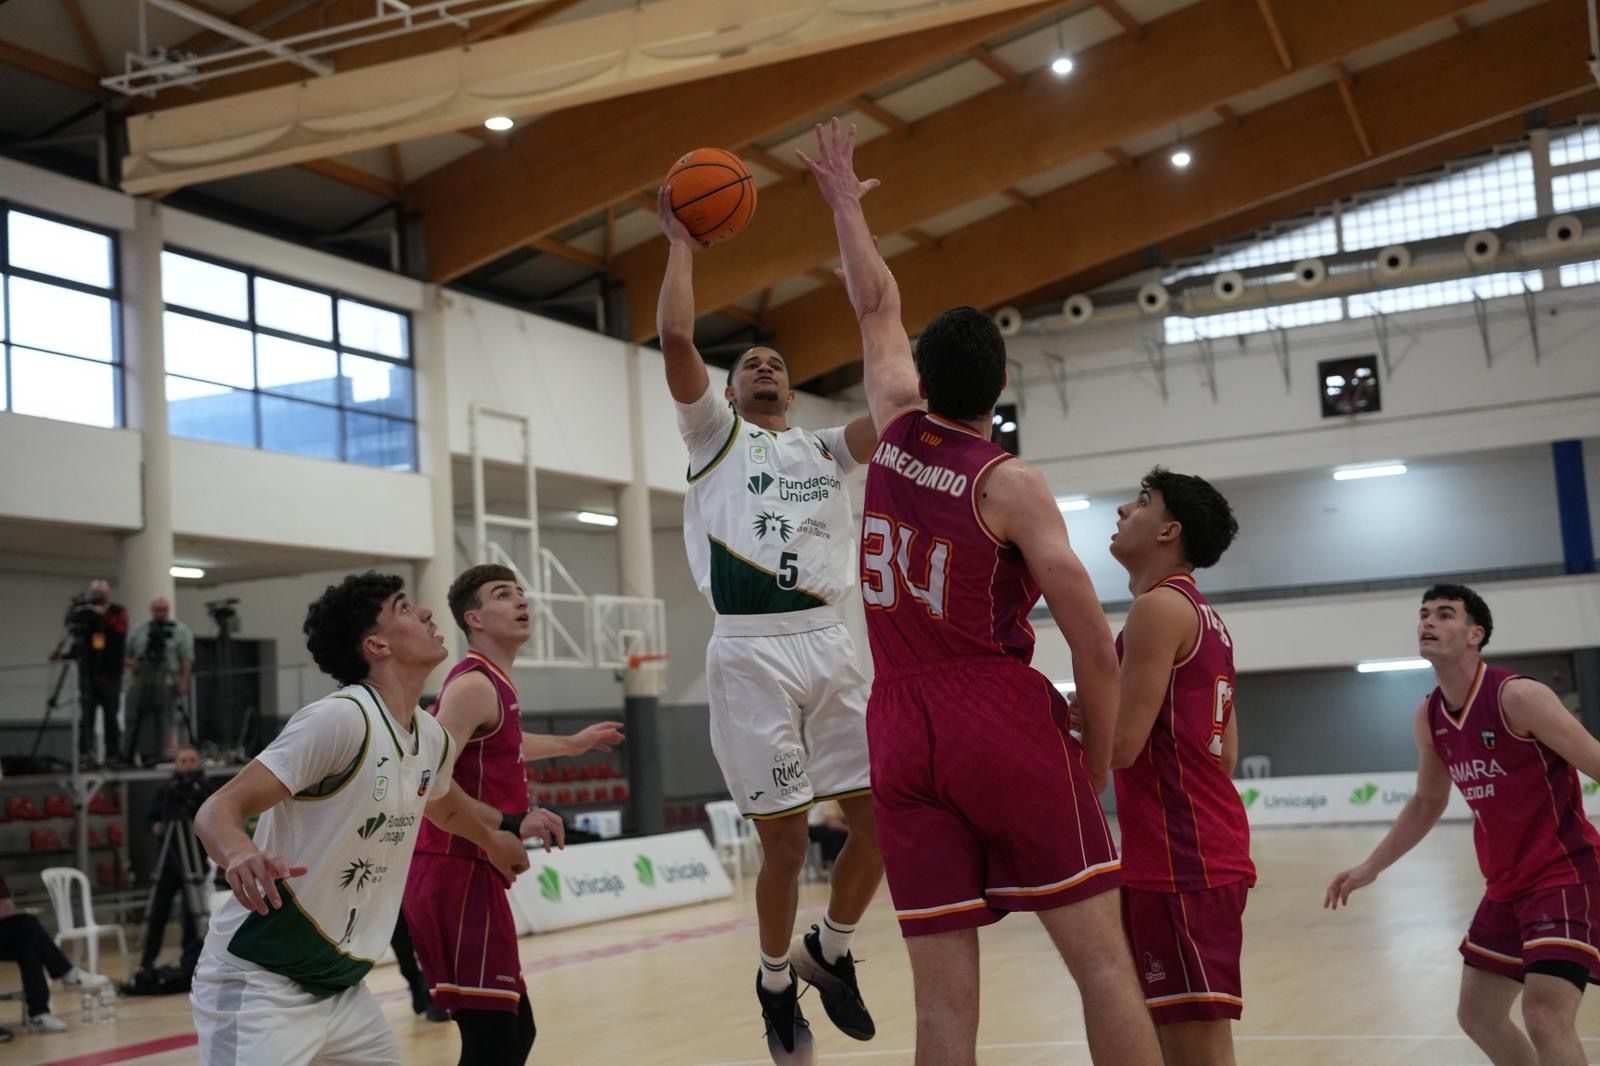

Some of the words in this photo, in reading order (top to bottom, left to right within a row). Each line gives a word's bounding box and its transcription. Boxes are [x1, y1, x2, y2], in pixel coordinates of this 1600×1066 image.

[779, 474, 841, 491] Fundación
[872, 441, 968, 498] ARREDONDO
[779, 486, 829, 503] Unicaja
[777, 551, 799, 590] 5
[861, 511, 952, 621] 34
[1263, 792, 1328, 811] Unicaja
[564, 870, 625, 897] Unicaja
[658, 858, 711, 884] Unicaja
